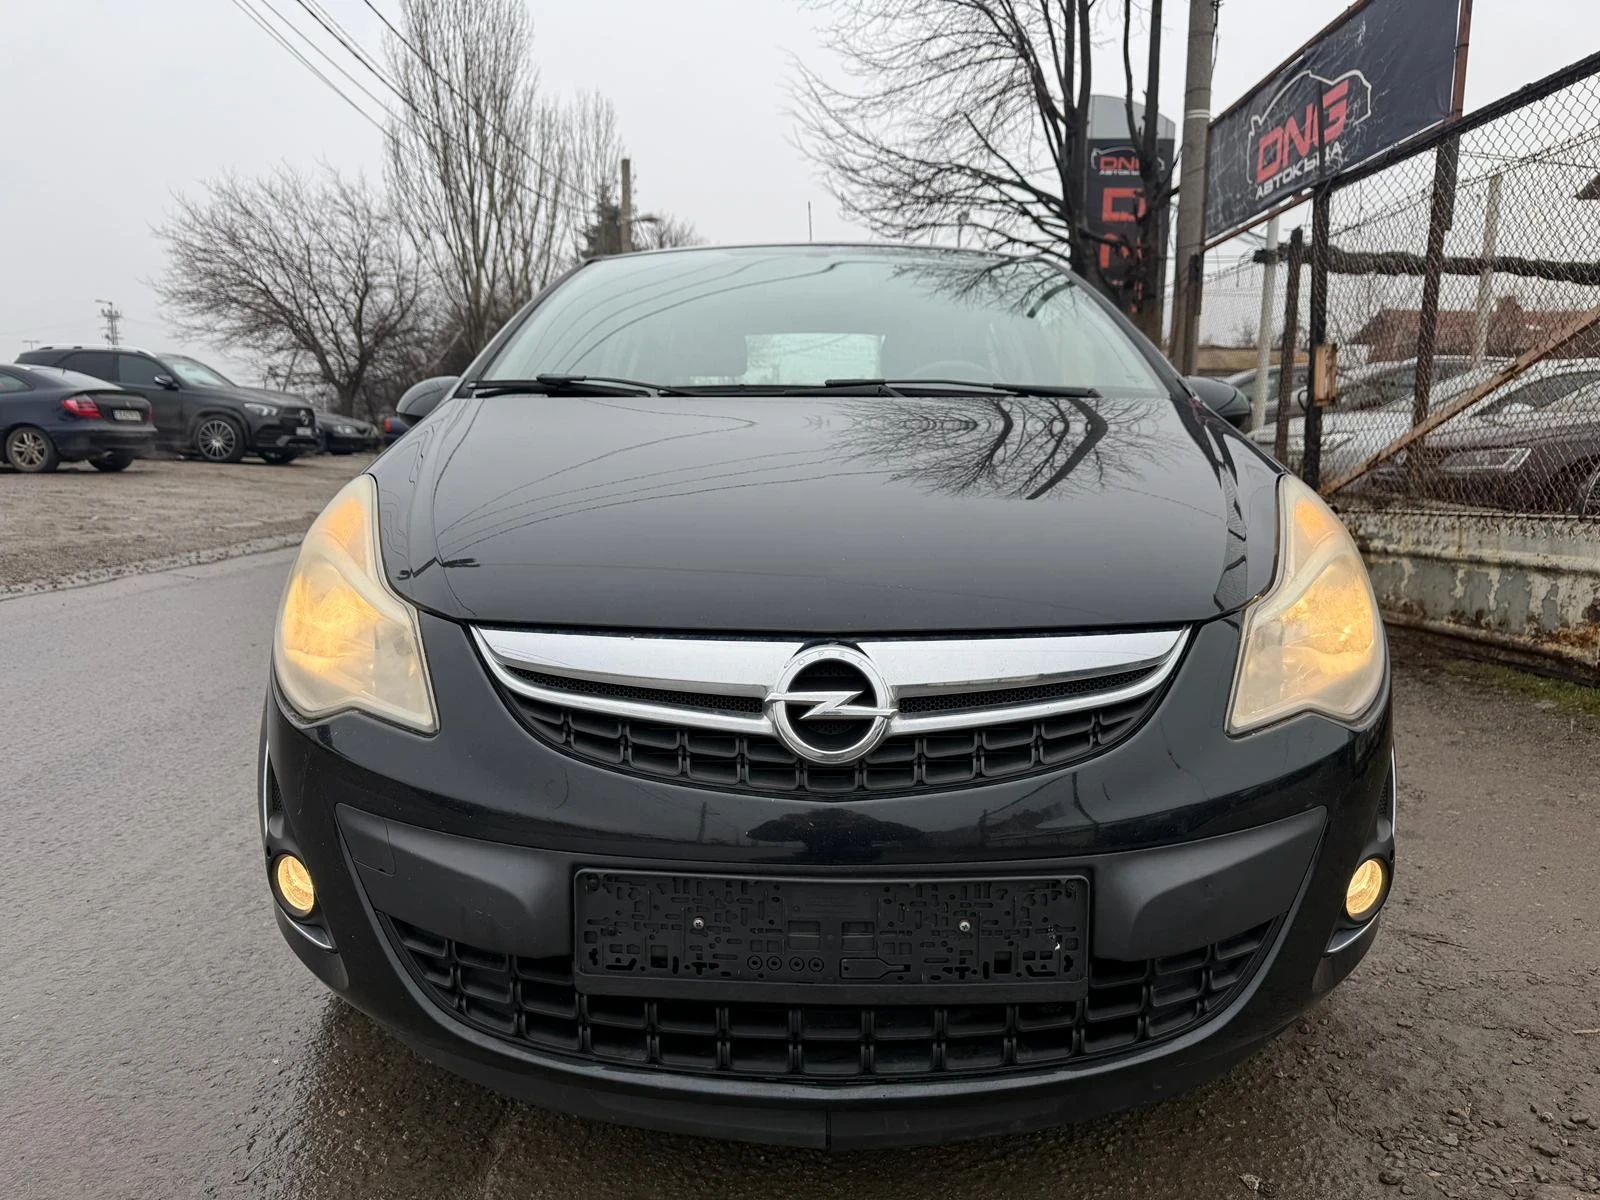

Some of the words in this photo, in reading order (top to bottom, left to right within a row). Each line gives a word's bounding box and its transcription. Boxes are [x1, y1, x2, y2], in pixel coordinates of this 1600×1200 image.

[1257, 80, 1348, 184] DNG
[1100, 156, 1140, 170] DN
[797, 651, 865, 668] OPEL
